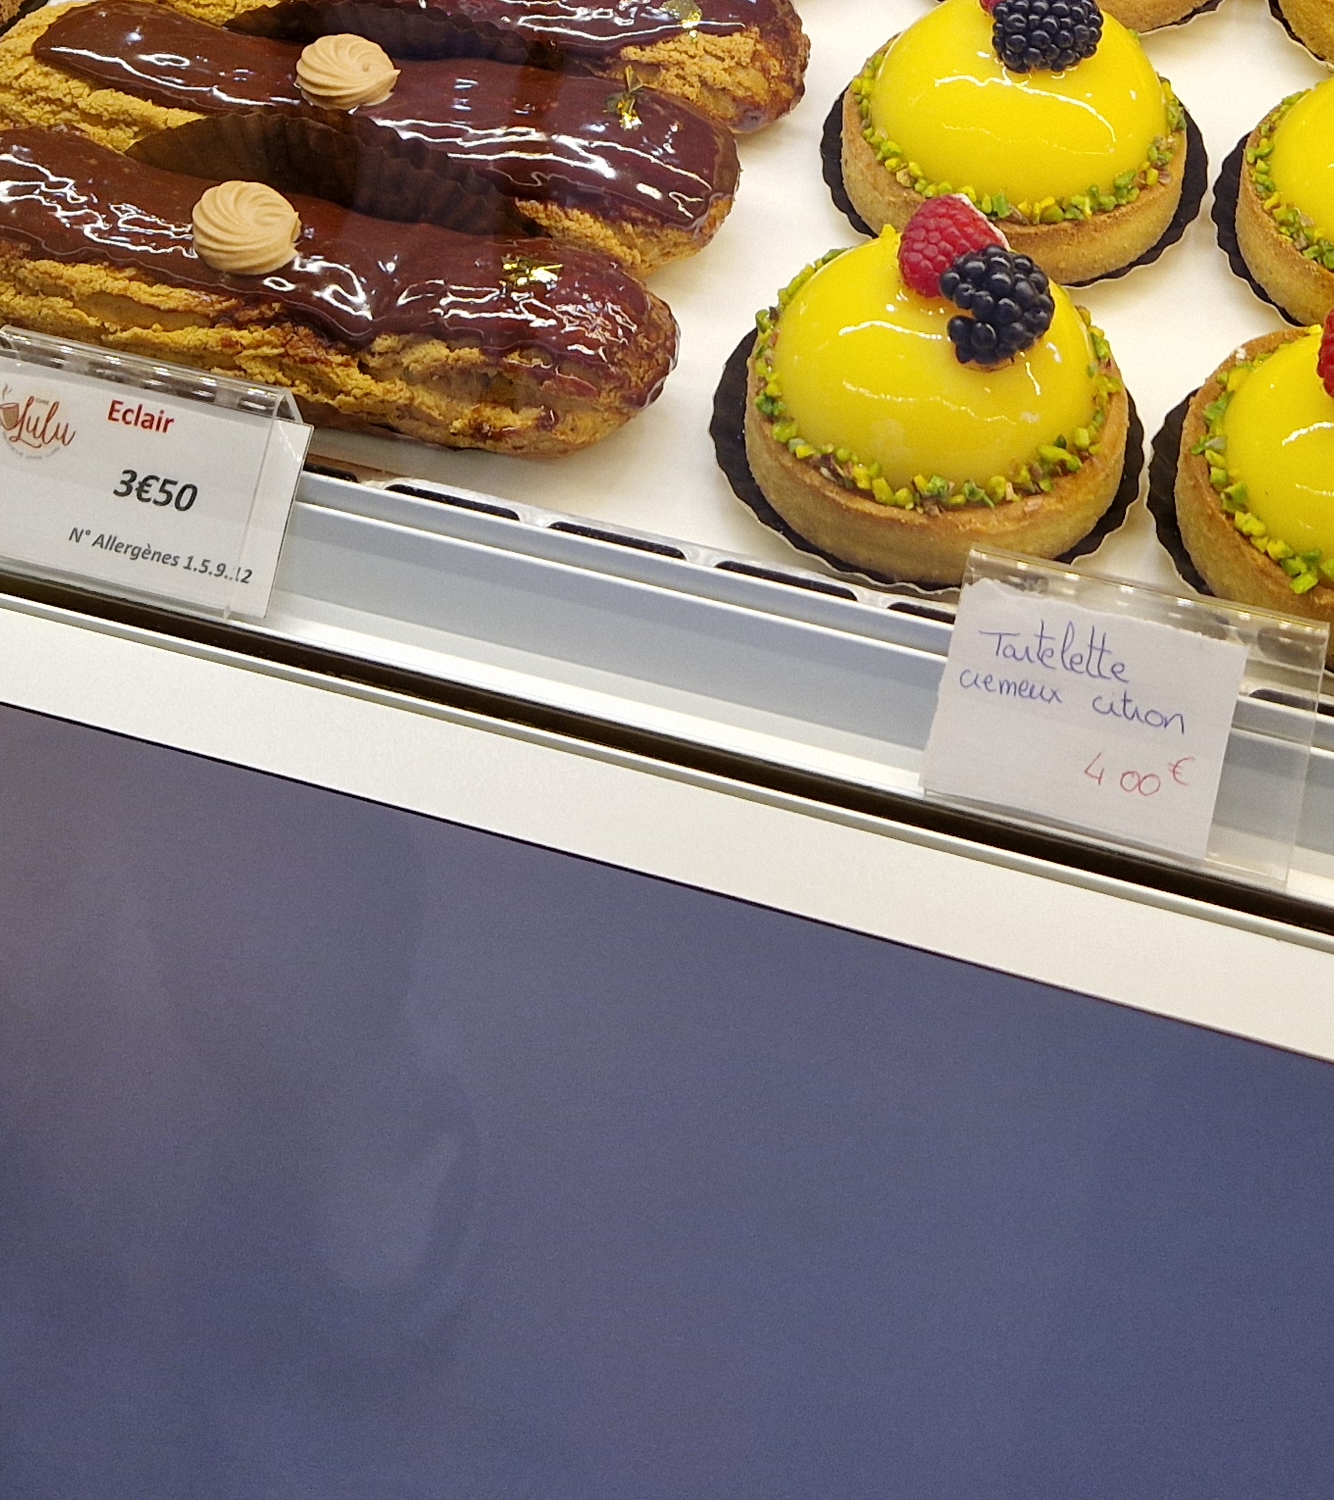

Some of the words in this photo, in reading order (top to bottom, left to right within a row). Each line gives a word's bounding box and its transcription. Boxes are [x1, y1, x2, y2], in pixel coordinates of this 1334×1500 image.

[9, 395, 77, 448] Lulu
[107, 399, 175, 434] Eclair
[113, 468, 198, 512] 3€50
[68, 526, 91, 543] N°
[92, 532, 180, 567] Allergènes
[979, 619, 1130, 684] Tartelette
[1092, 690, 1185, 735] citron
